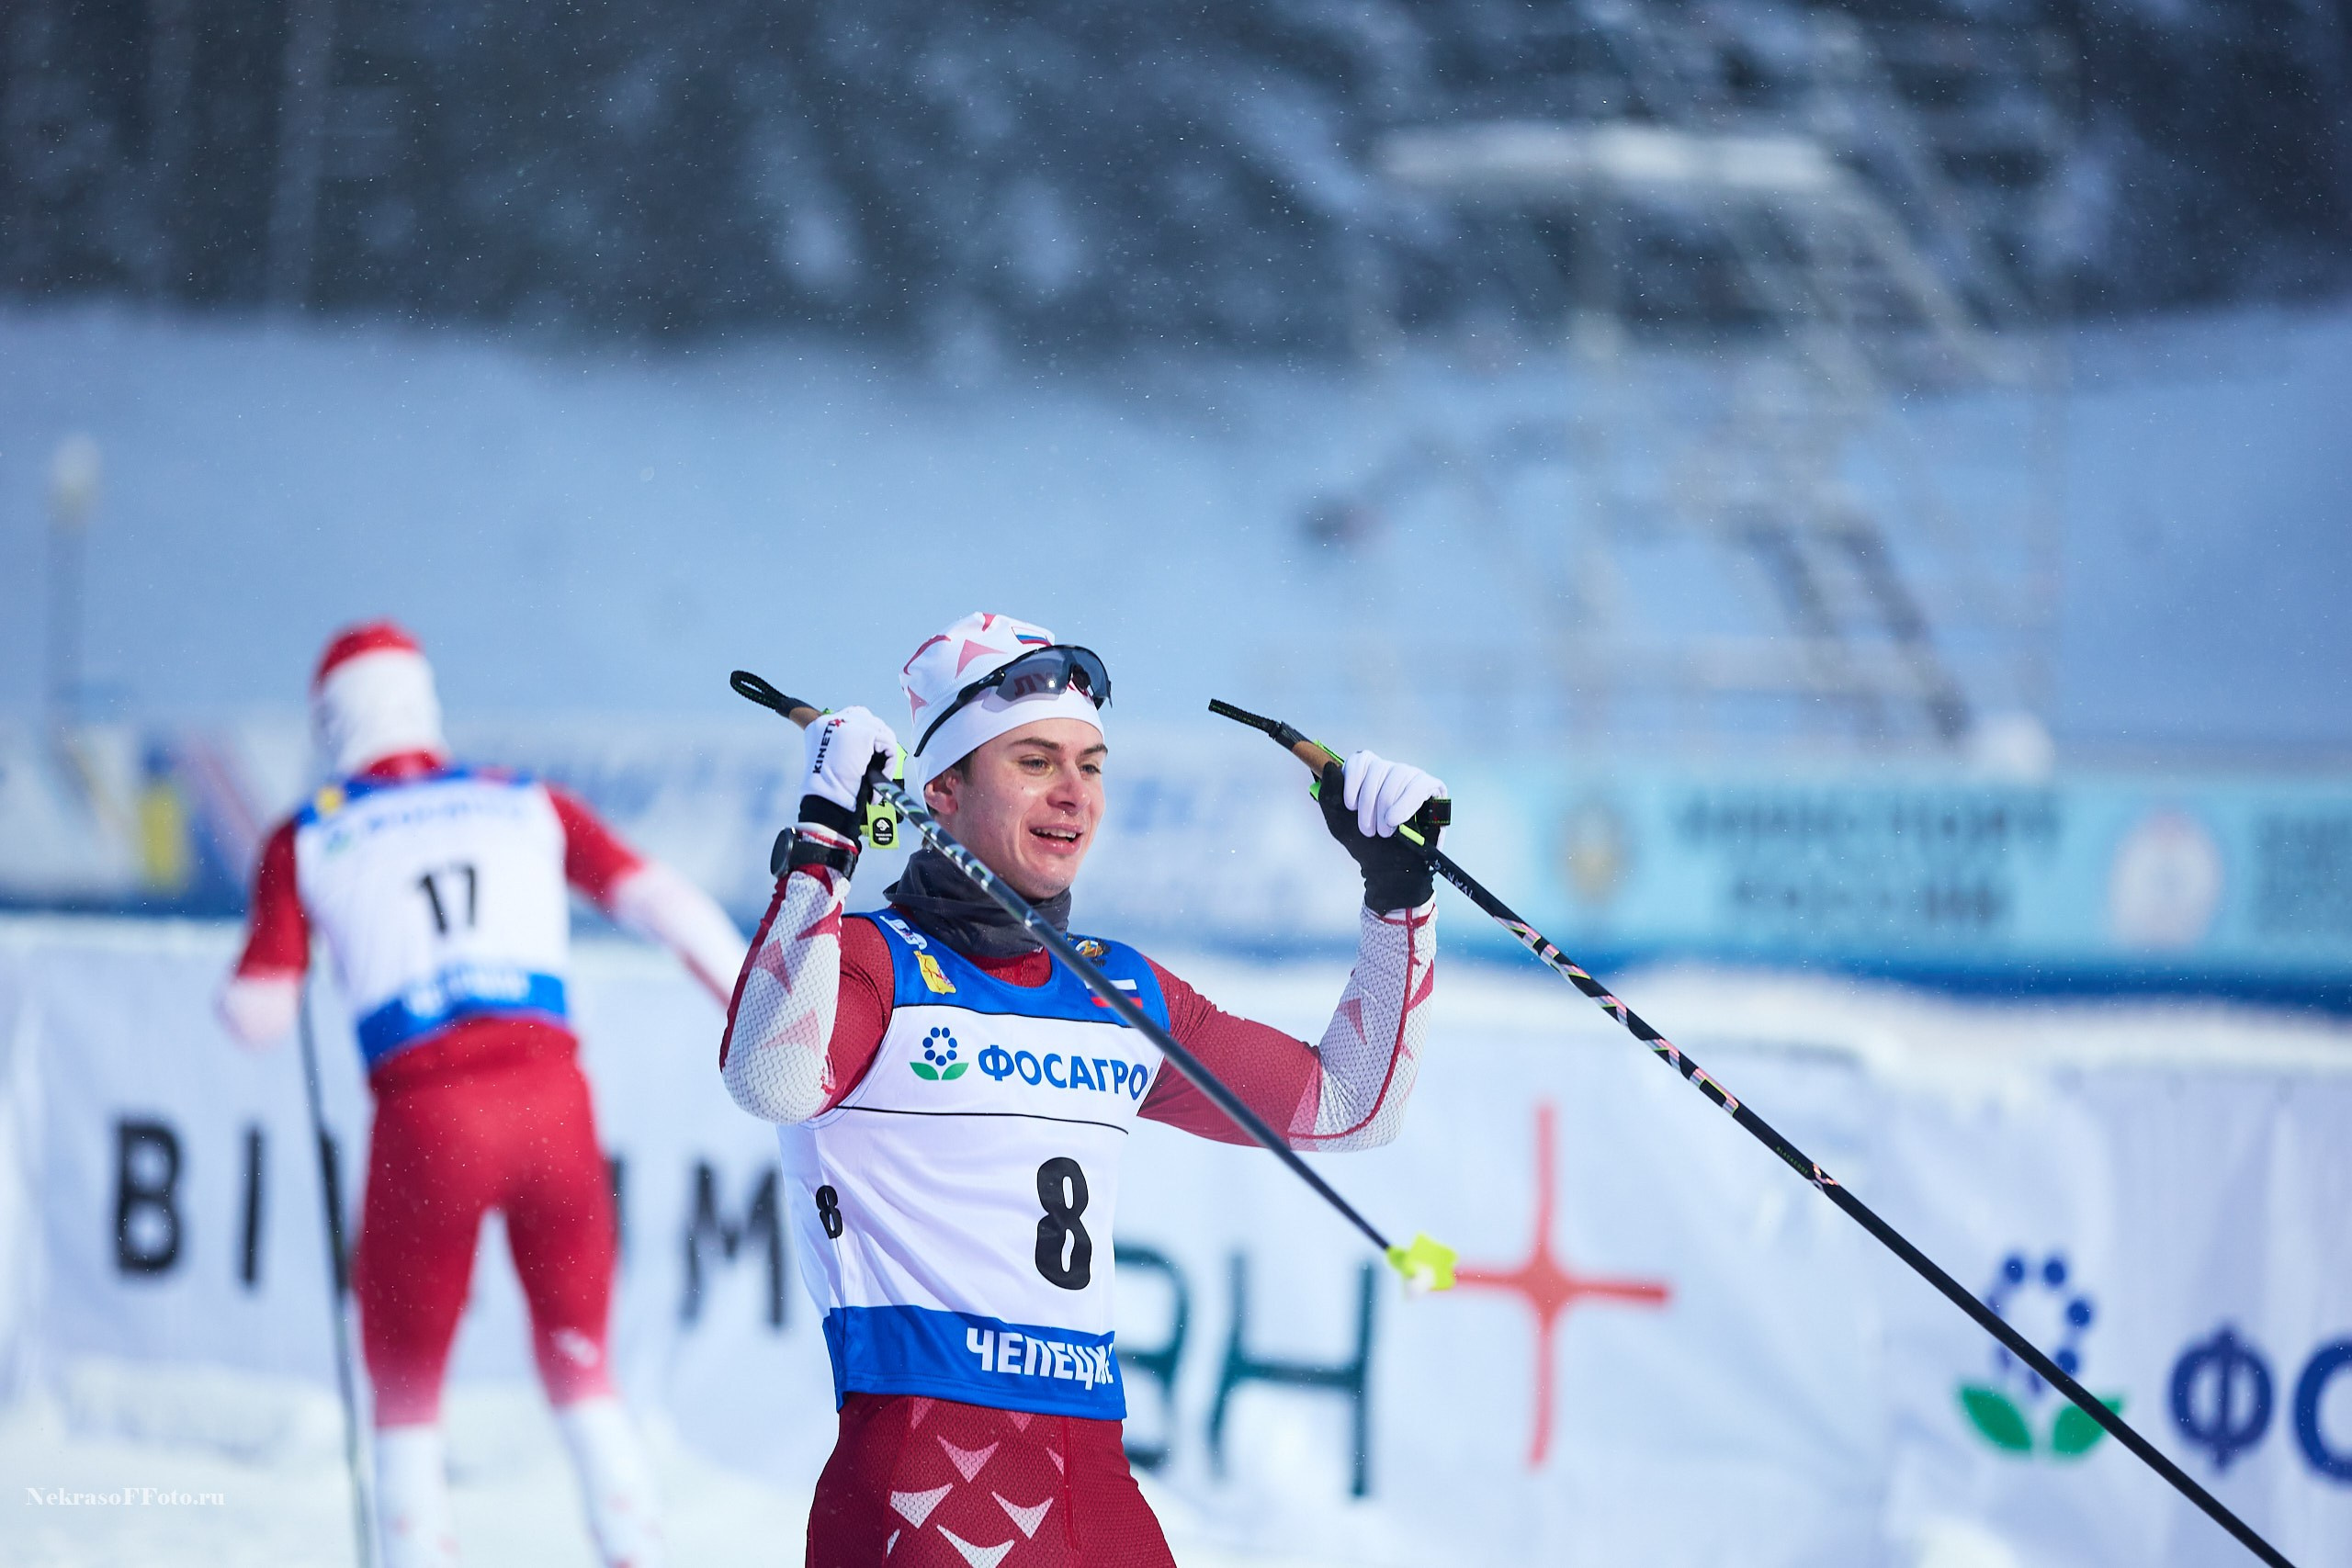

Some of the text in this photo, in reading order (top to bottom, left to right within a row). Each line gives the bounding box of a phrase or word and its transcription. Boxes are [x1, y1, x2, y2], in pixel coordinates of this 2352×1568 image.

[413, 861, 478, 935] 17
[978, 1044, 1148, 1100] ФОСАГРО
[816, 1185, 842, 1239] 8
[1035, 1156, 1092, 1291] 8
